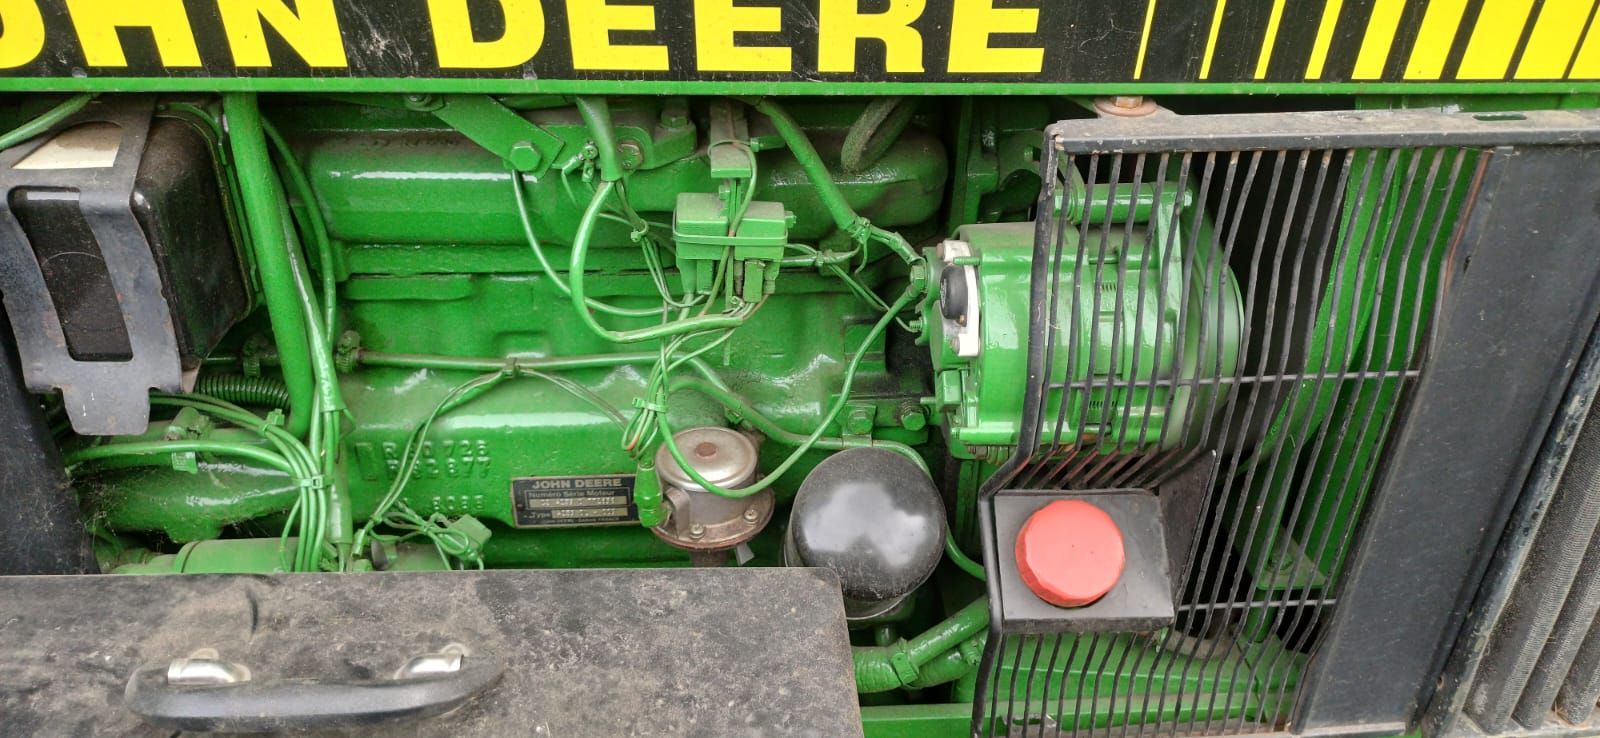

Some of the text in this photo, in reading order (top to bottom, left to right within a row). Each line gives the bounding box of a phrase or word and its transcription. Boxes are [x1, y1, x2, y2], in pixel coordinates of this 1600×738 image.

[426, 0, 1045, 72] DEERE
[532, 478, 622, 489] JOHN DEERE
[587, 489, 615, 497] Moteur
